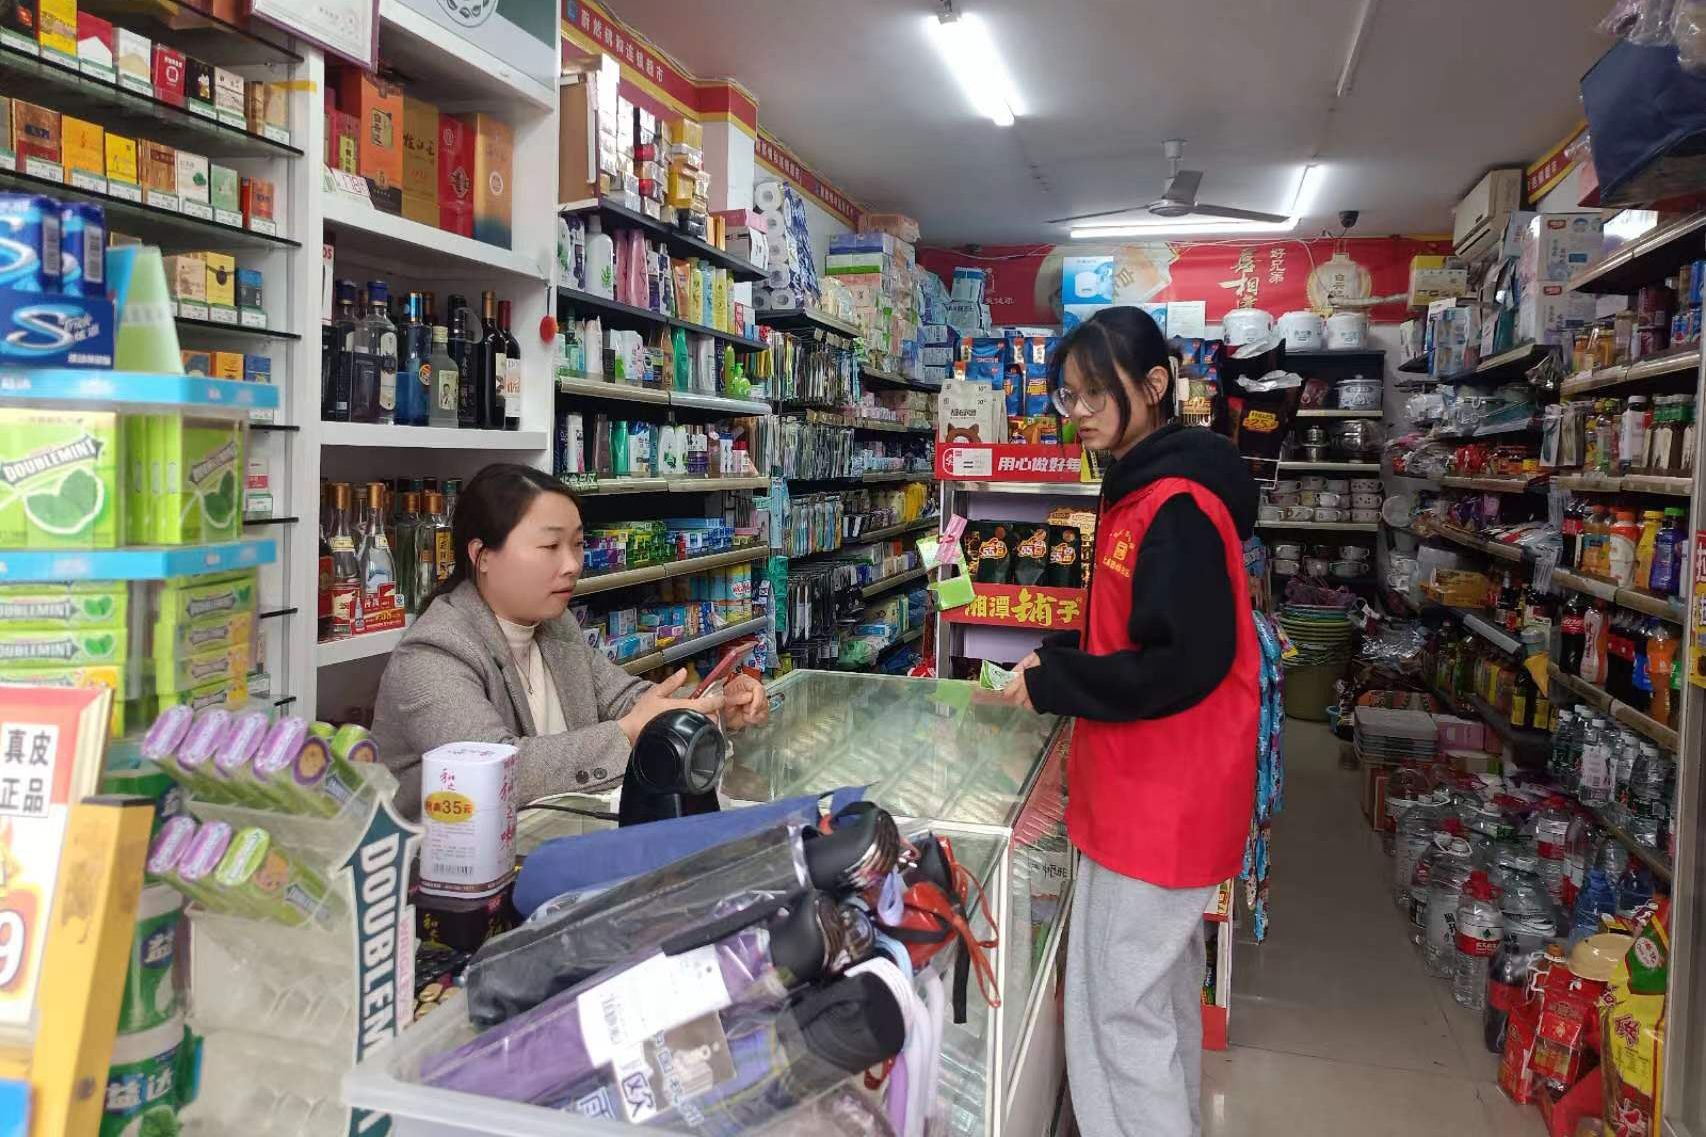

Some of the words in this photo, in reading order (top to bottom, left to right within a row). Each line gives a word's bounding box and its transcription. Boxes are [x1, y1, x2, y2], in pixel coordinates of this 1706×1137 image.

[2, 434, 98, 486] DOUBLEMINT
[964, 587, 1081, 626] 湘潭铺子
[4, 728, 52, 766] 真皮
[0, 777, 45, 814] 正品
